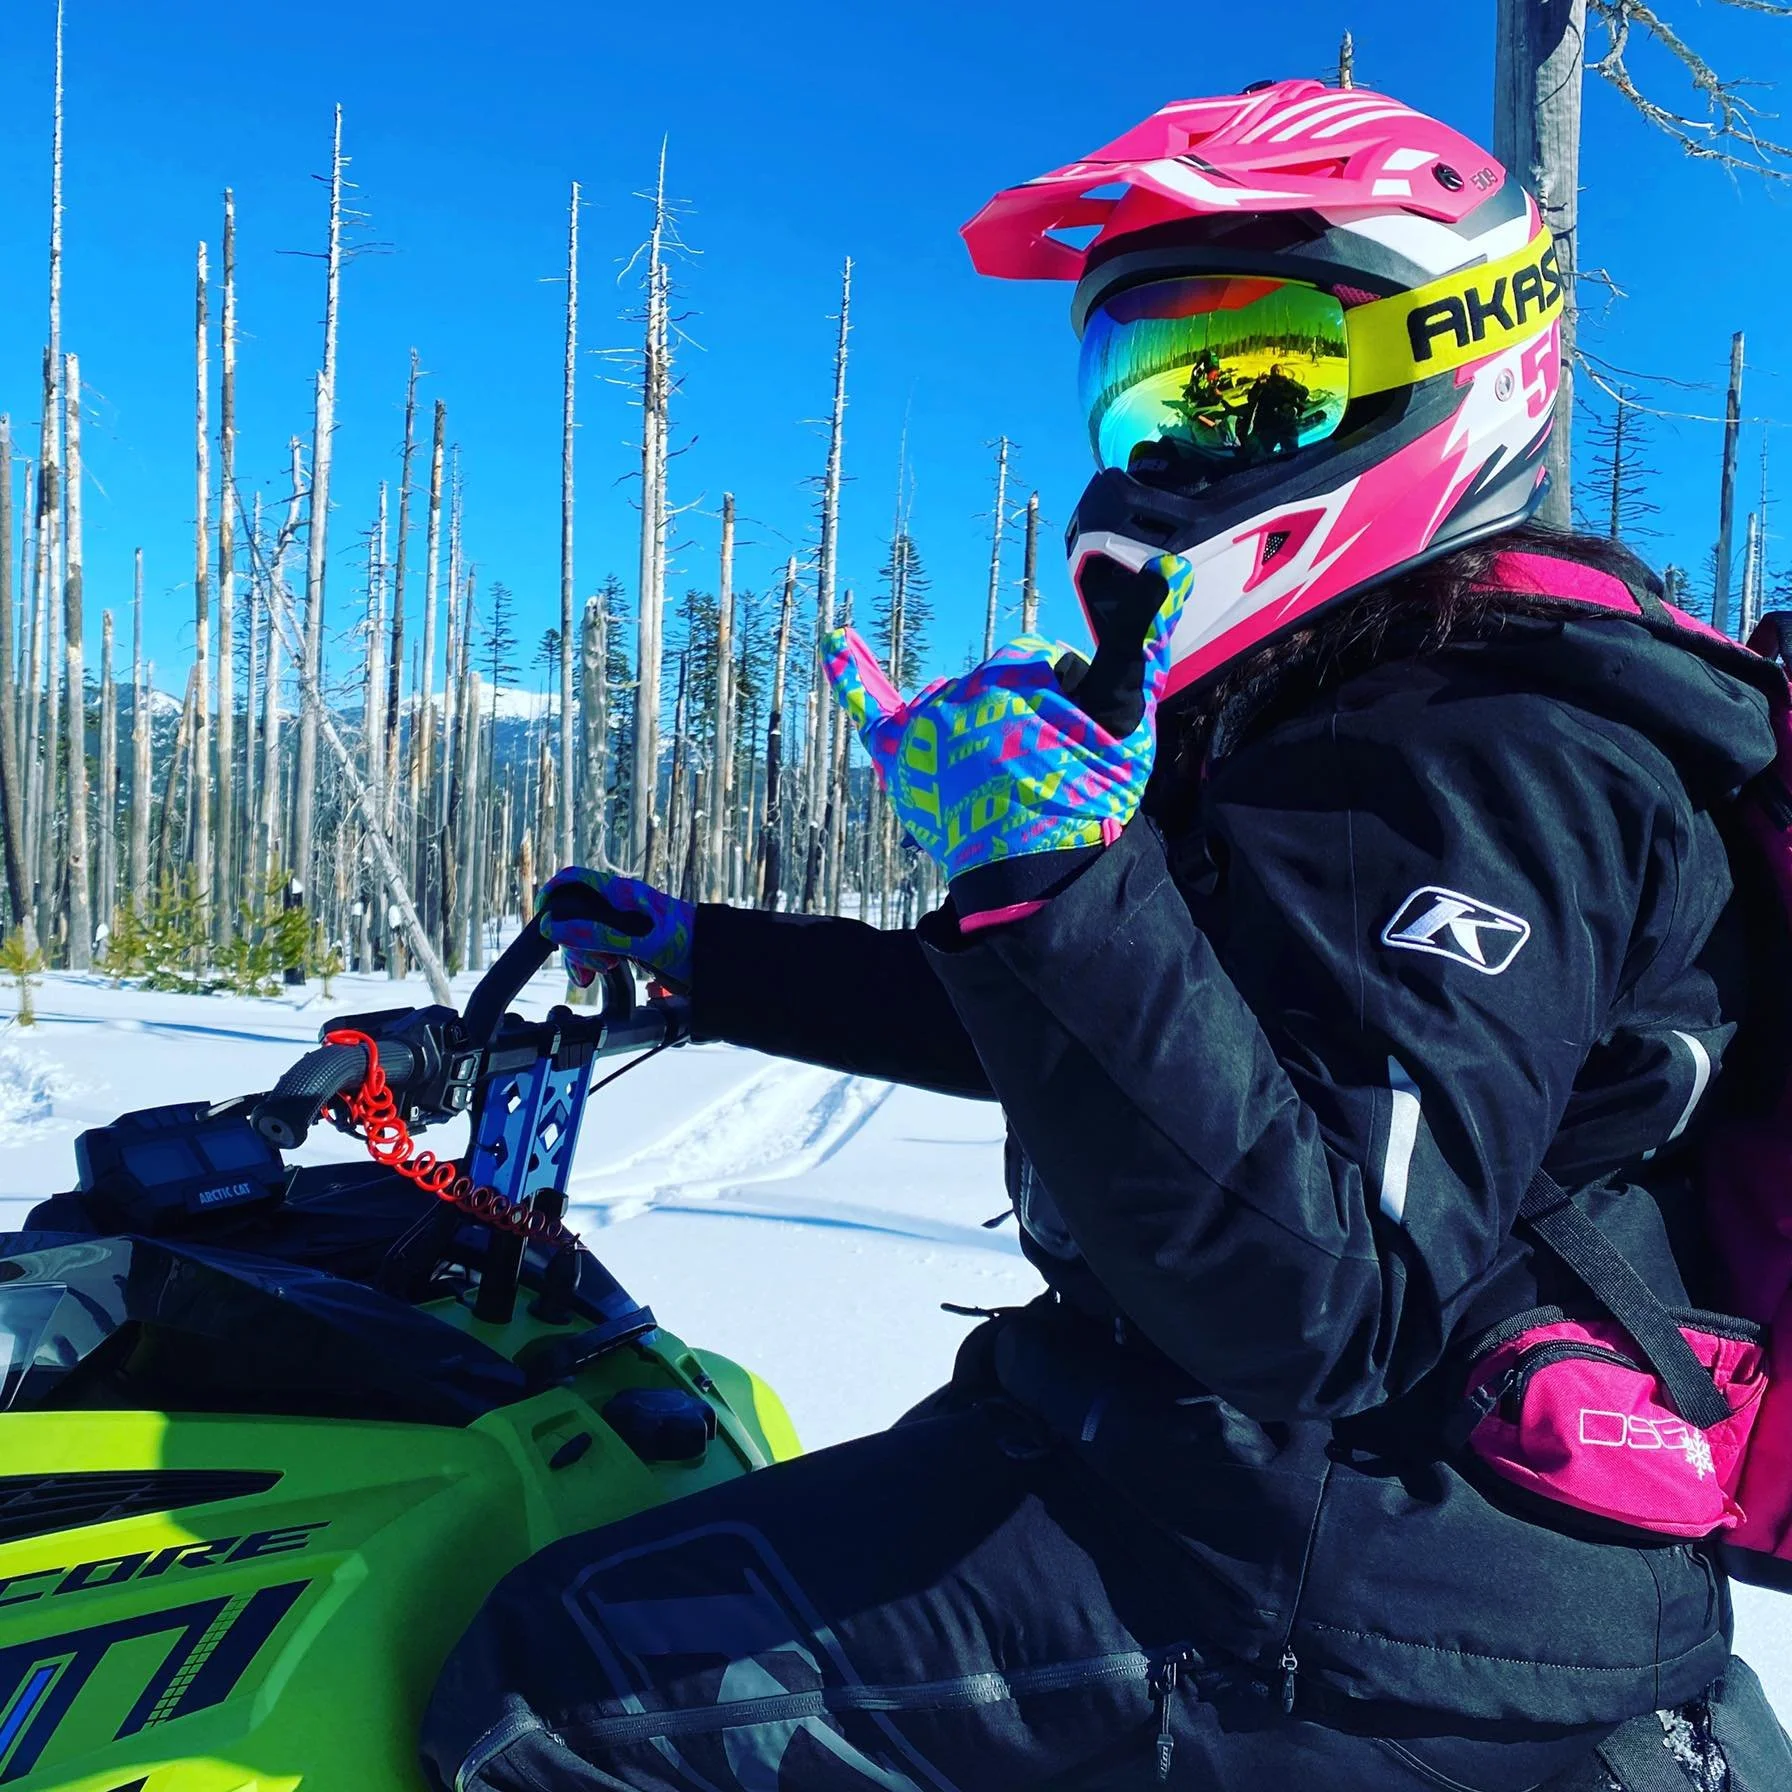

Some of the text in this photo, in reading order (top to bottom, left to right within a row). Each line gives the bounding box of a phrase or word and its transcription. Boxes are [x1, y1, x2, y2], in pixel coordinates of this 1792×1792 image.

[1469, 168, 1498, 191] 509
[199, 1182, 251, 1204] ARCTIC CAT
